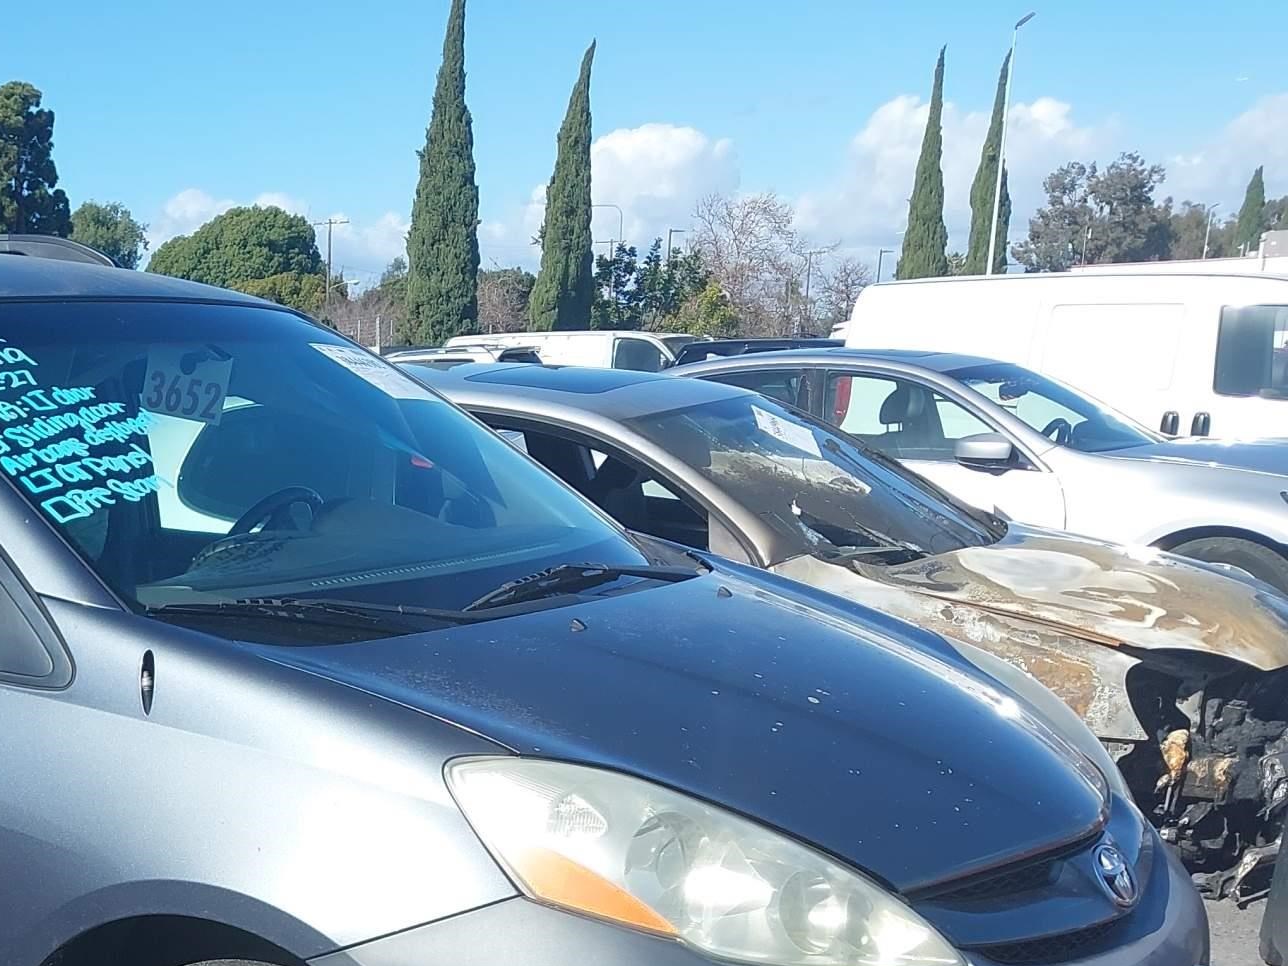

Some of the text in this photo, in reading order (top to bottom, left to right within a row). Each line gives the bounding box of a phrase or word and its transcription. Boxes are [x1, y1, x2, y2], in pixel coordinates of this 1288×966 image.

[52, 386, 97, 405] door
[147, 370, 222, 420] 3652
[78, 401, 126, 424] door
